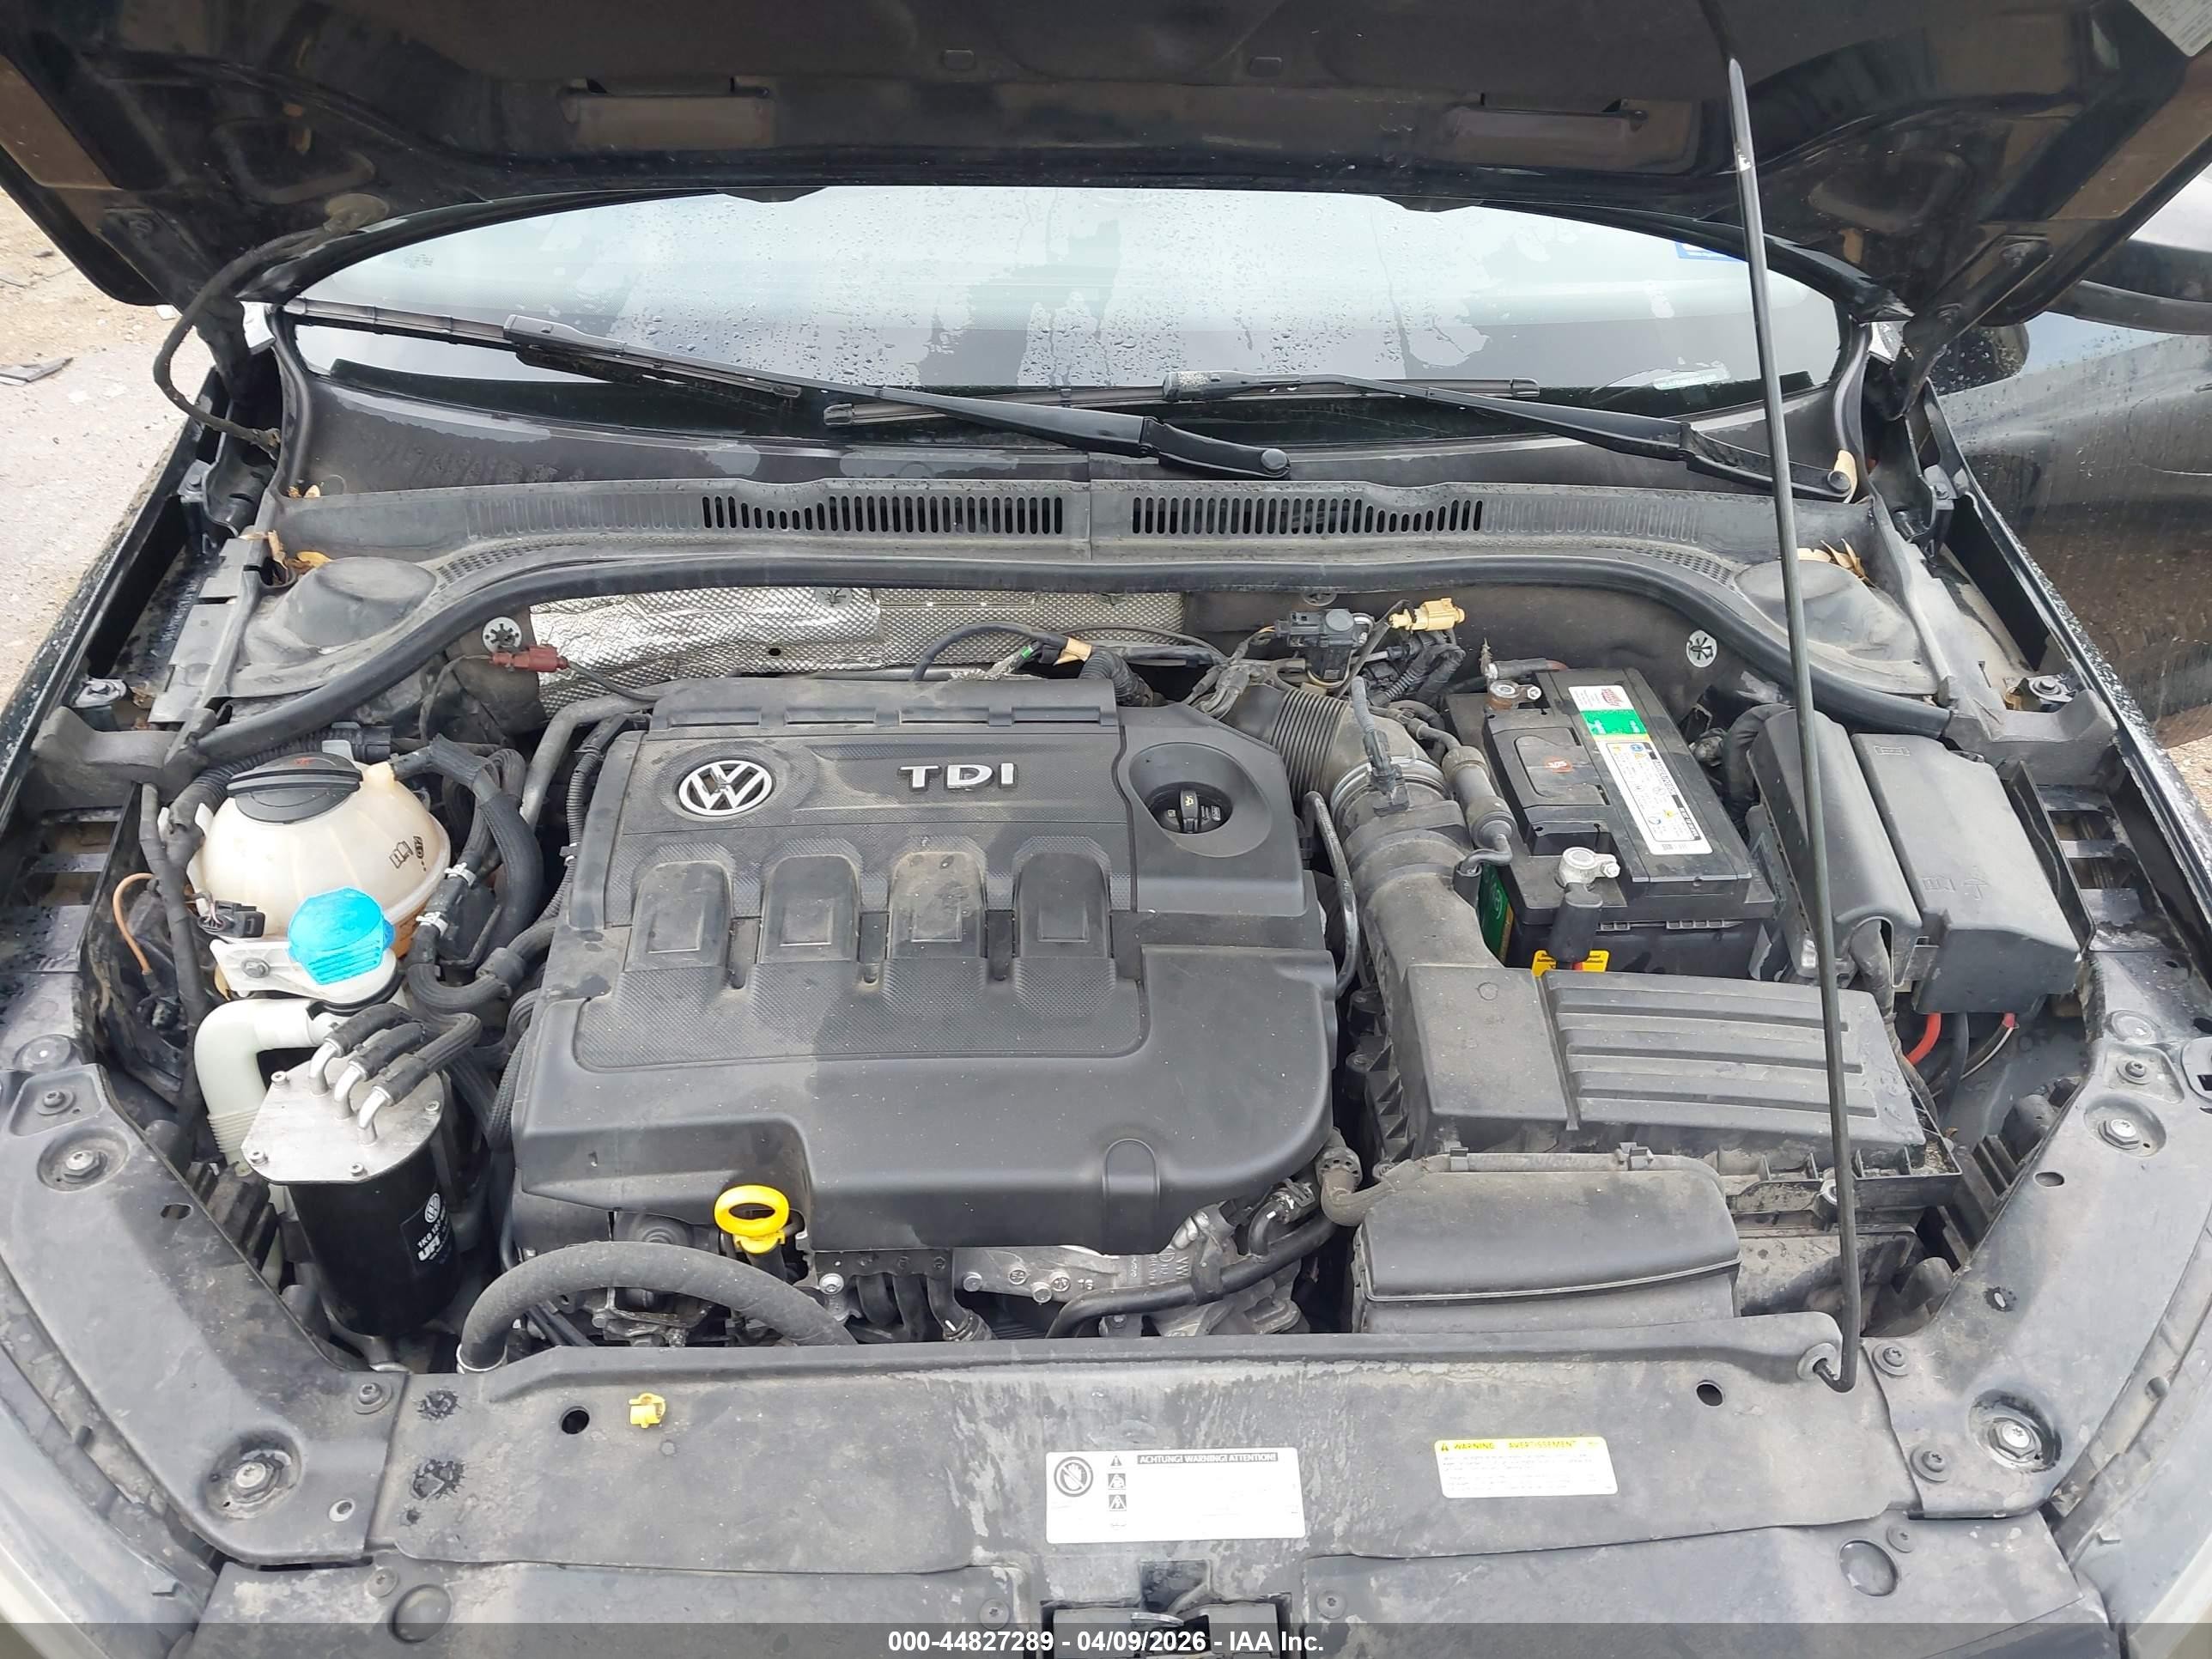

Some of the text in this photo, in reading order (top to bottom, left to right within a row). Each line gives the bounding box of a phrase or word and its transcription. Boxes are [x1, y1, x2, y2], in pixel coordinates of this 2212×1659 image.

[900, 763, 1017, 789] TDI
[417, 1235, 441, 1261] UFI
[1139, 1455, 1183, 1464] ACHTUNG!
[1184, 1454, 1227, 1463] WARNING!
